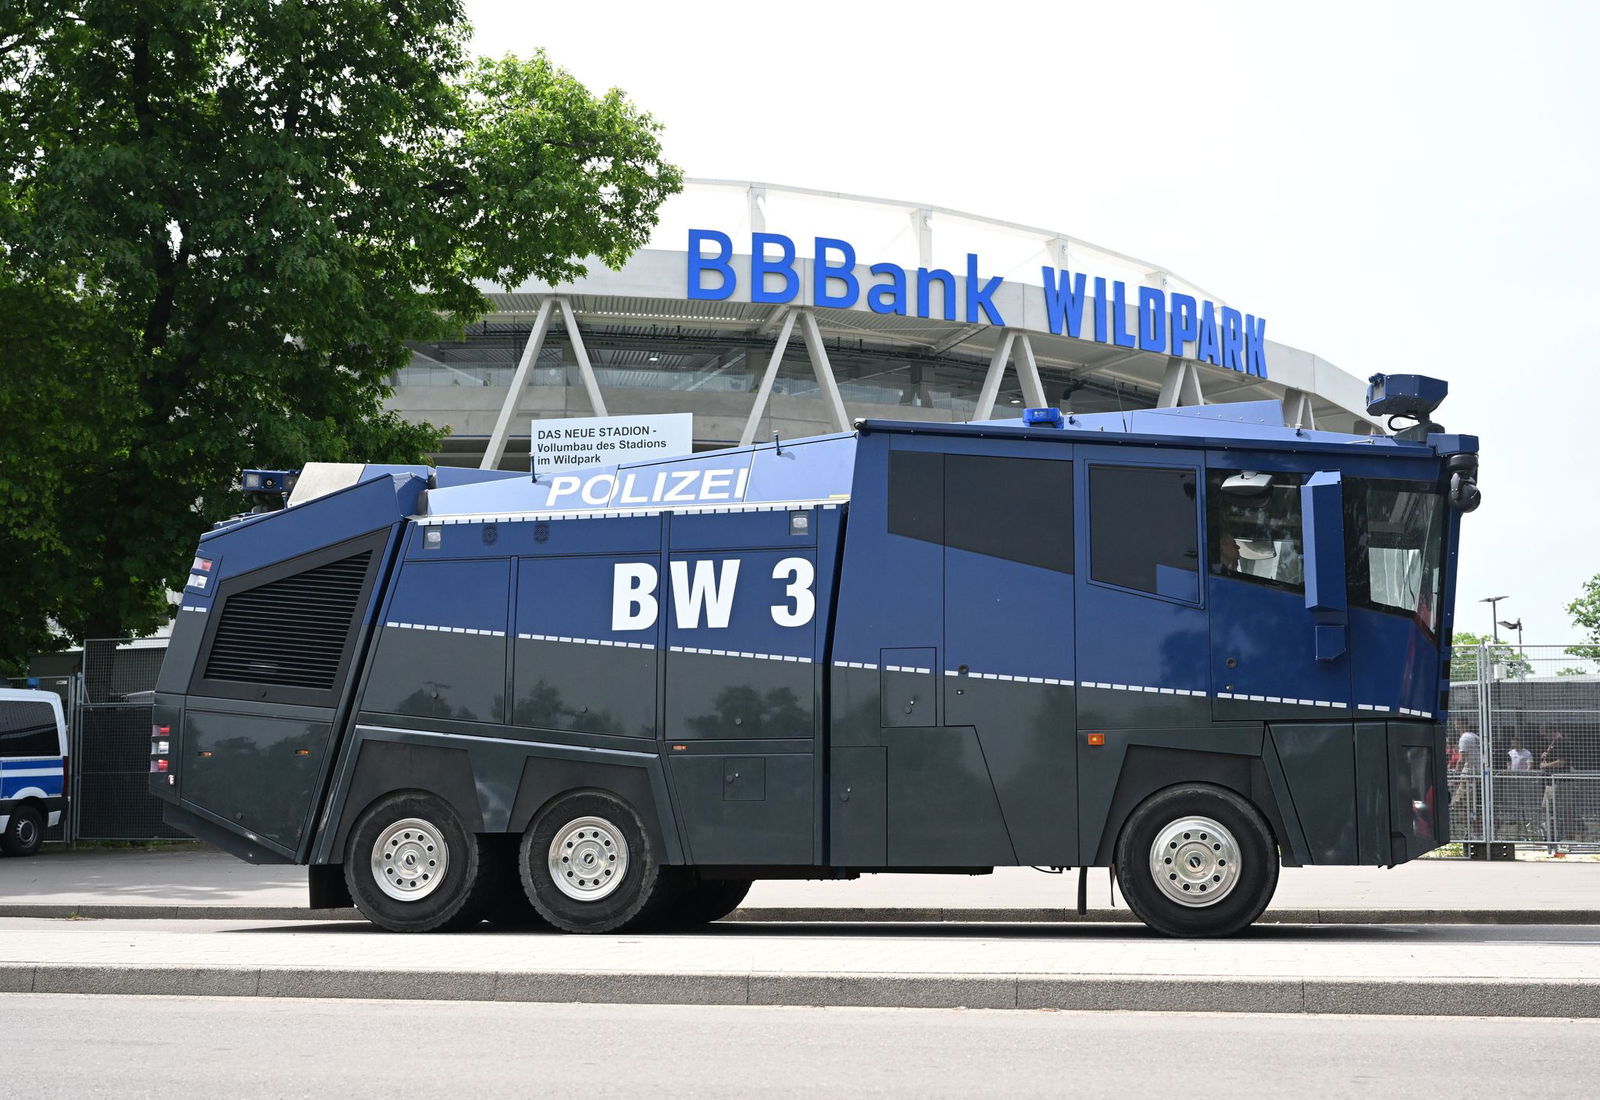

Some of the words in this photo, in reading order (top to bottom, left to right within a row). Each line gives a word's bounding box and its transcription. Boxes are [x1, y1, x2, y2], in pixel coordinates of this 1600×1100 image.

[687, 228, 1006, 326] BBBank
[1042, 265, 1268, 379] WILDPARK
[537, 429, 561, 440] DAS
[564, 428, 596, 438] NEUE
[598, 425, 650, 437] STADION
[537, 442, 593, 453] Vollumbau
[596, 440, 615, 450] des
[618, 439, 667, 449] Stadions
[537, 456, 550, 465] im
[553, 454, 601, 466] Wildpark
[545, 468, 750, 507] POLIZEI
[611, 559, 741, 631] BW
[770, 557, 815, 628] 3
